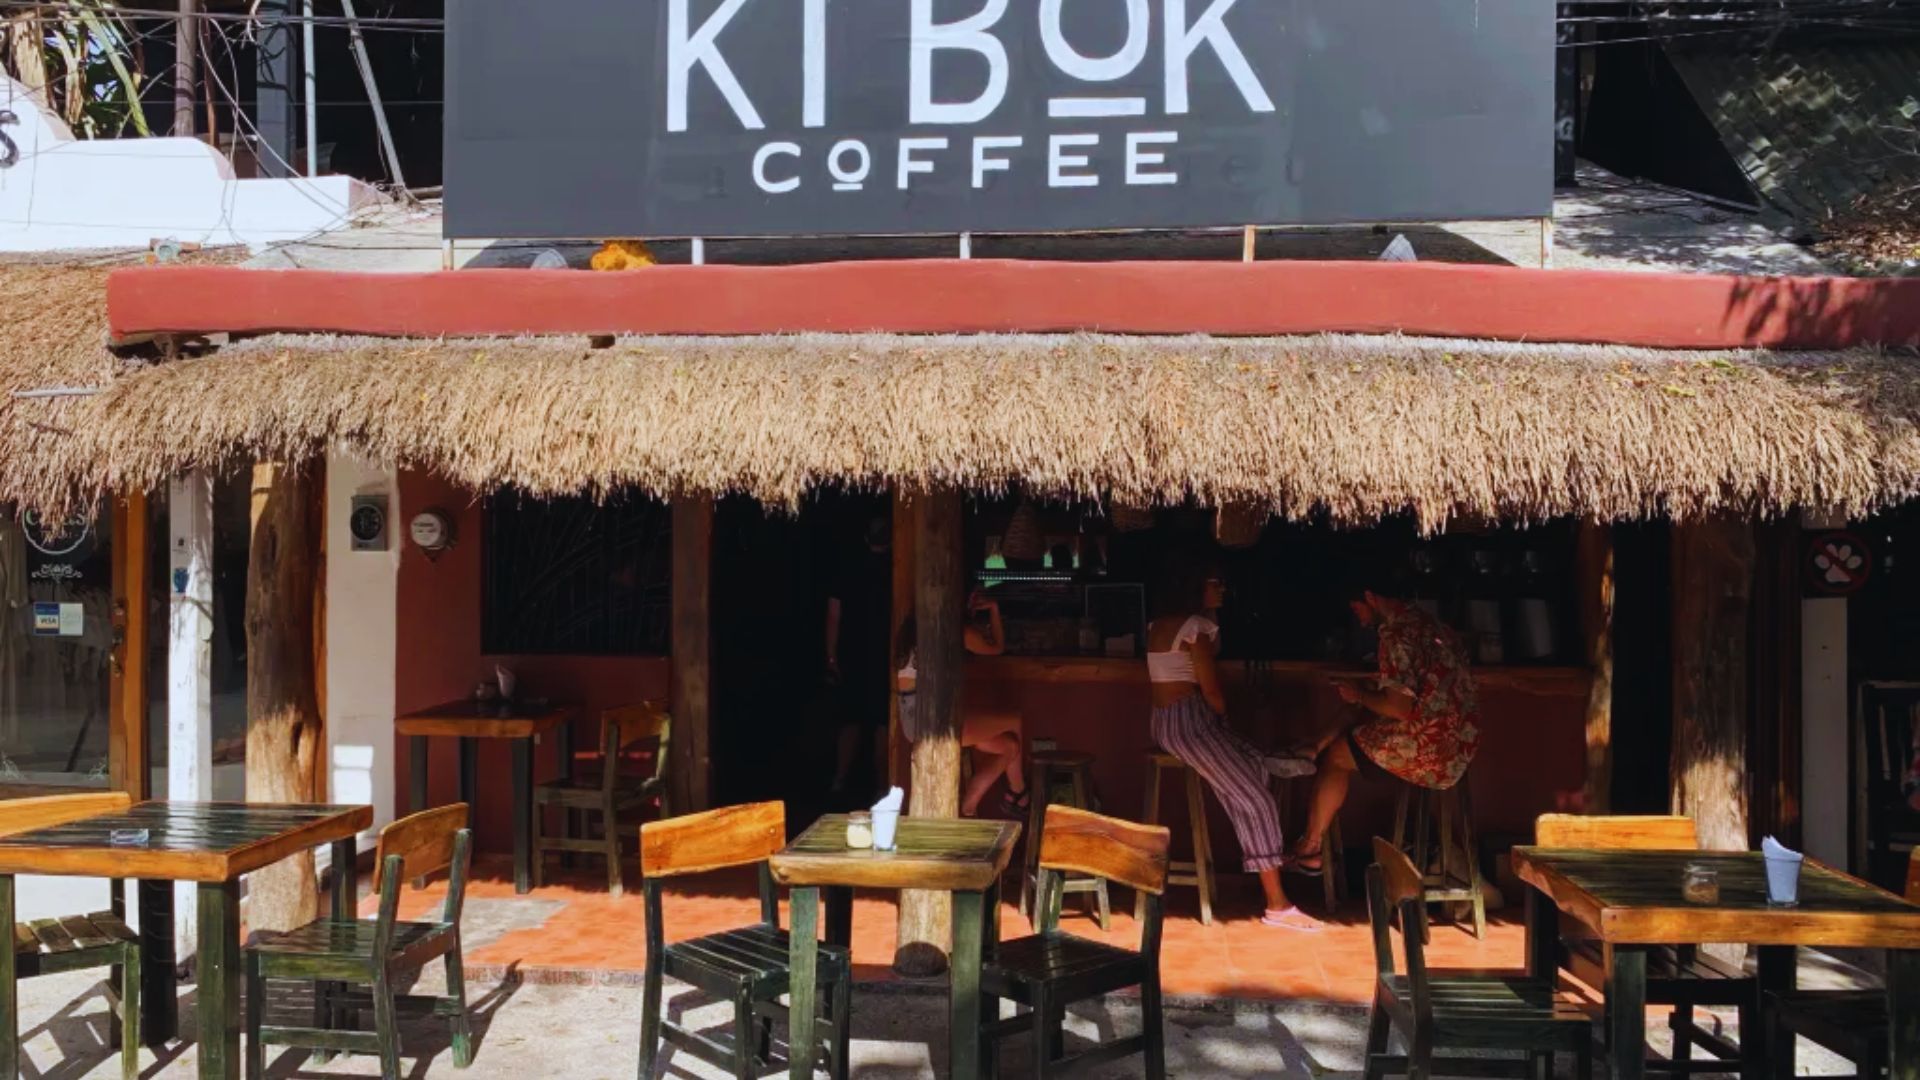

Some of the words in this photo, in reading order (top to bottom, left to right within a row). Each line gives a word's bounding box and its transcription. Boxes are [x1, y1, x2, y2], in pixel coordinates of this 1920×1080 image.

[667, 0, 825, 132] KI
[909, 0, 1275, 124] BOK
[752, 131, 1178, 194] COFFEE
